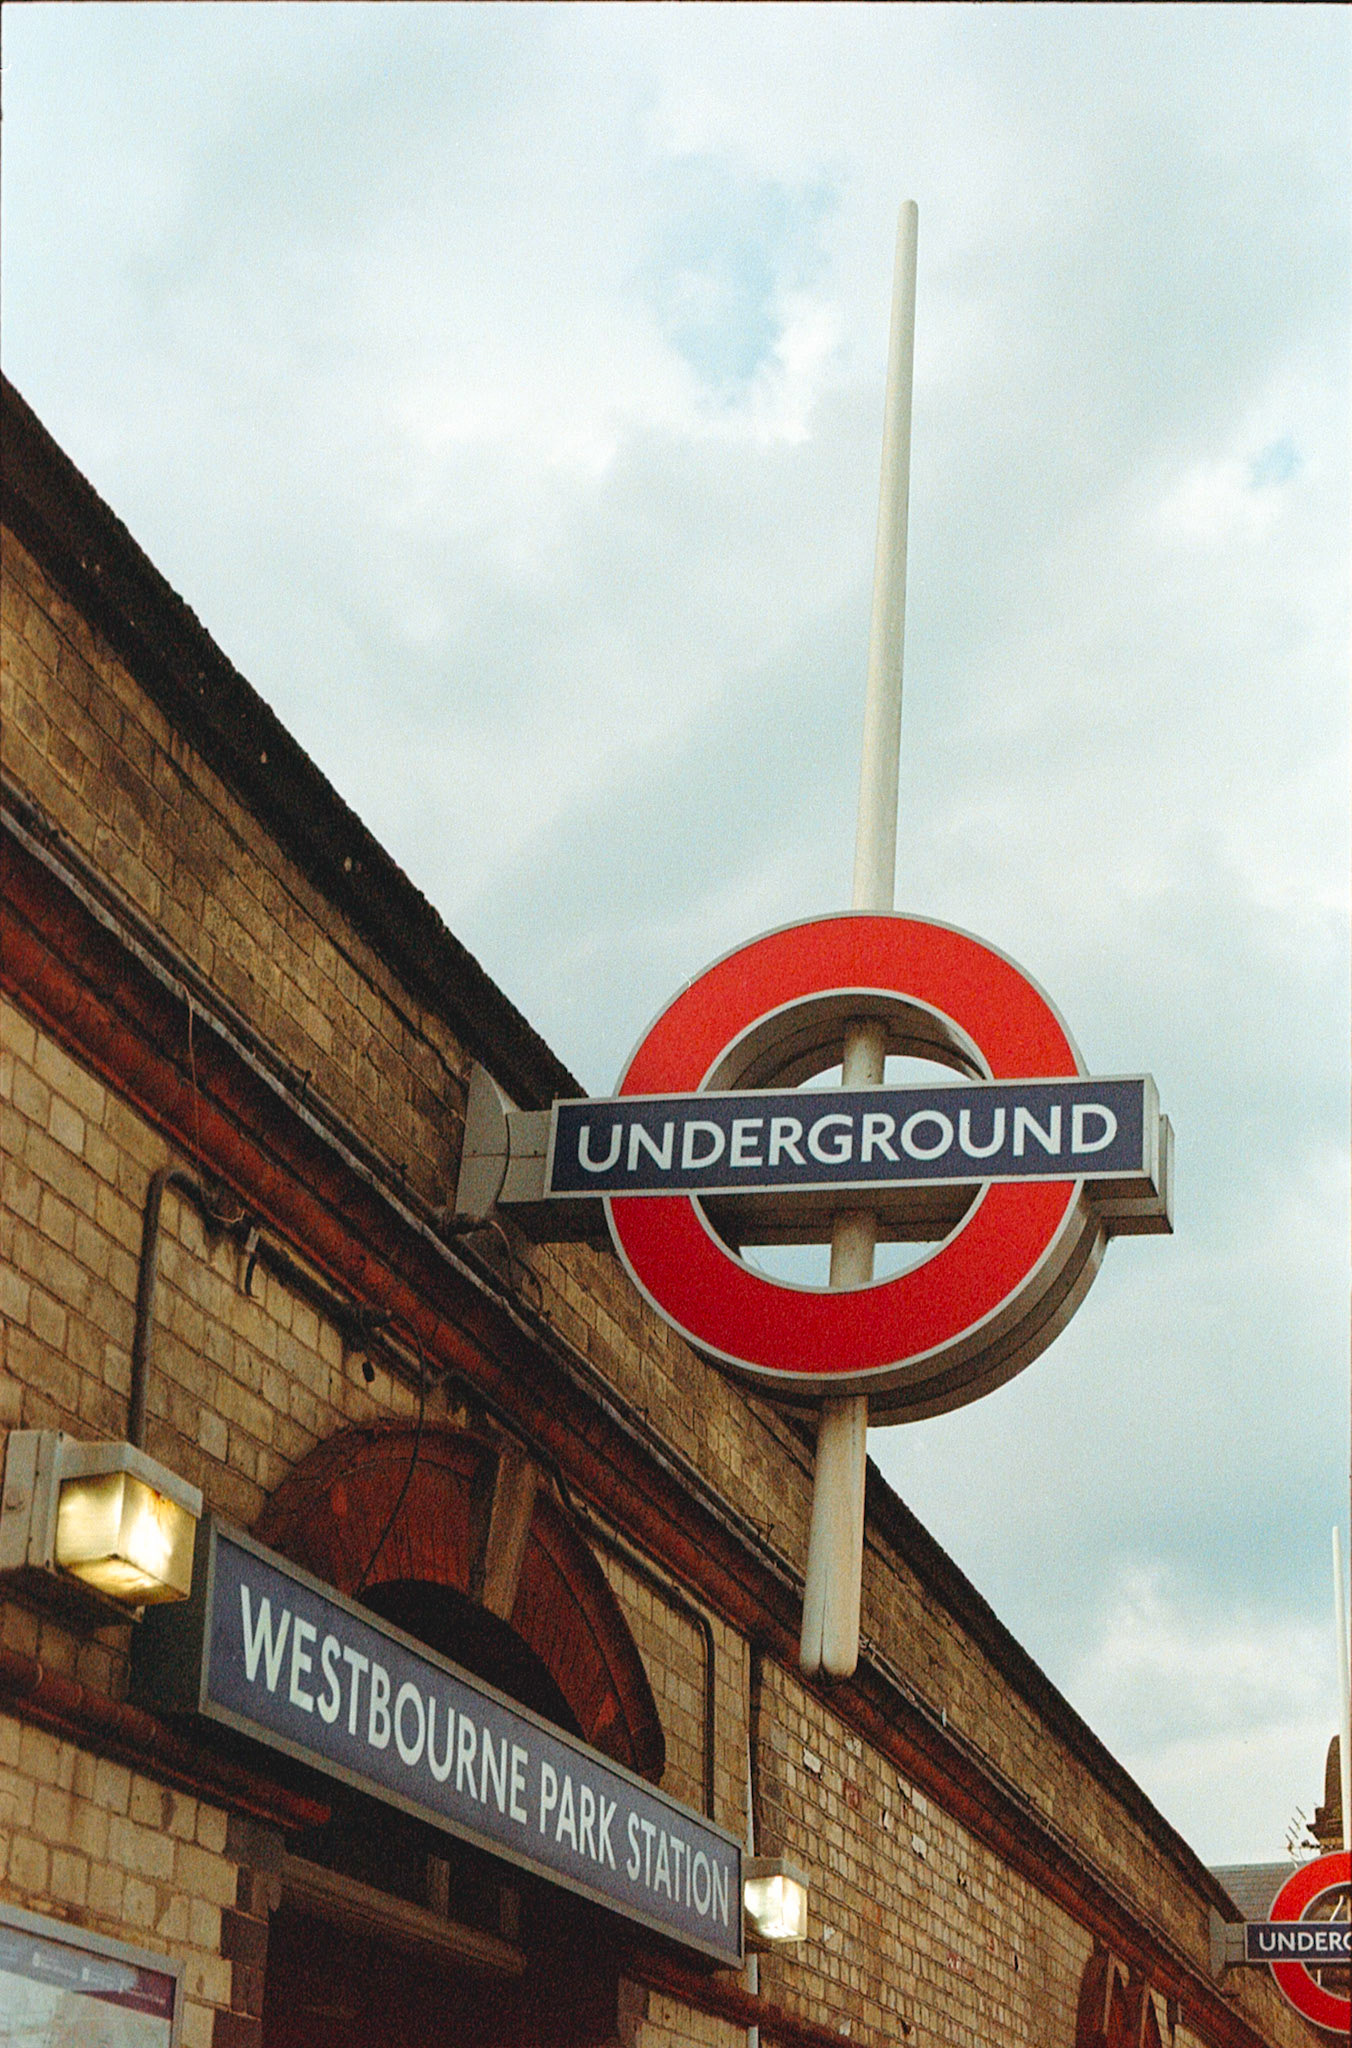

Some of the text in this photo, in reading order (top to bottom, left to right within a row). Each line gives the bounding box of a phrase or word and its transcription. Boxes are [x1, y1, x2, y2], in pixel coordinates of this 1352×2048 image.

[577, 1103, 1118, 1172] UNDERGROUND
[240, 1584, 730, 1926] WESTBOURNE PARK STATION
